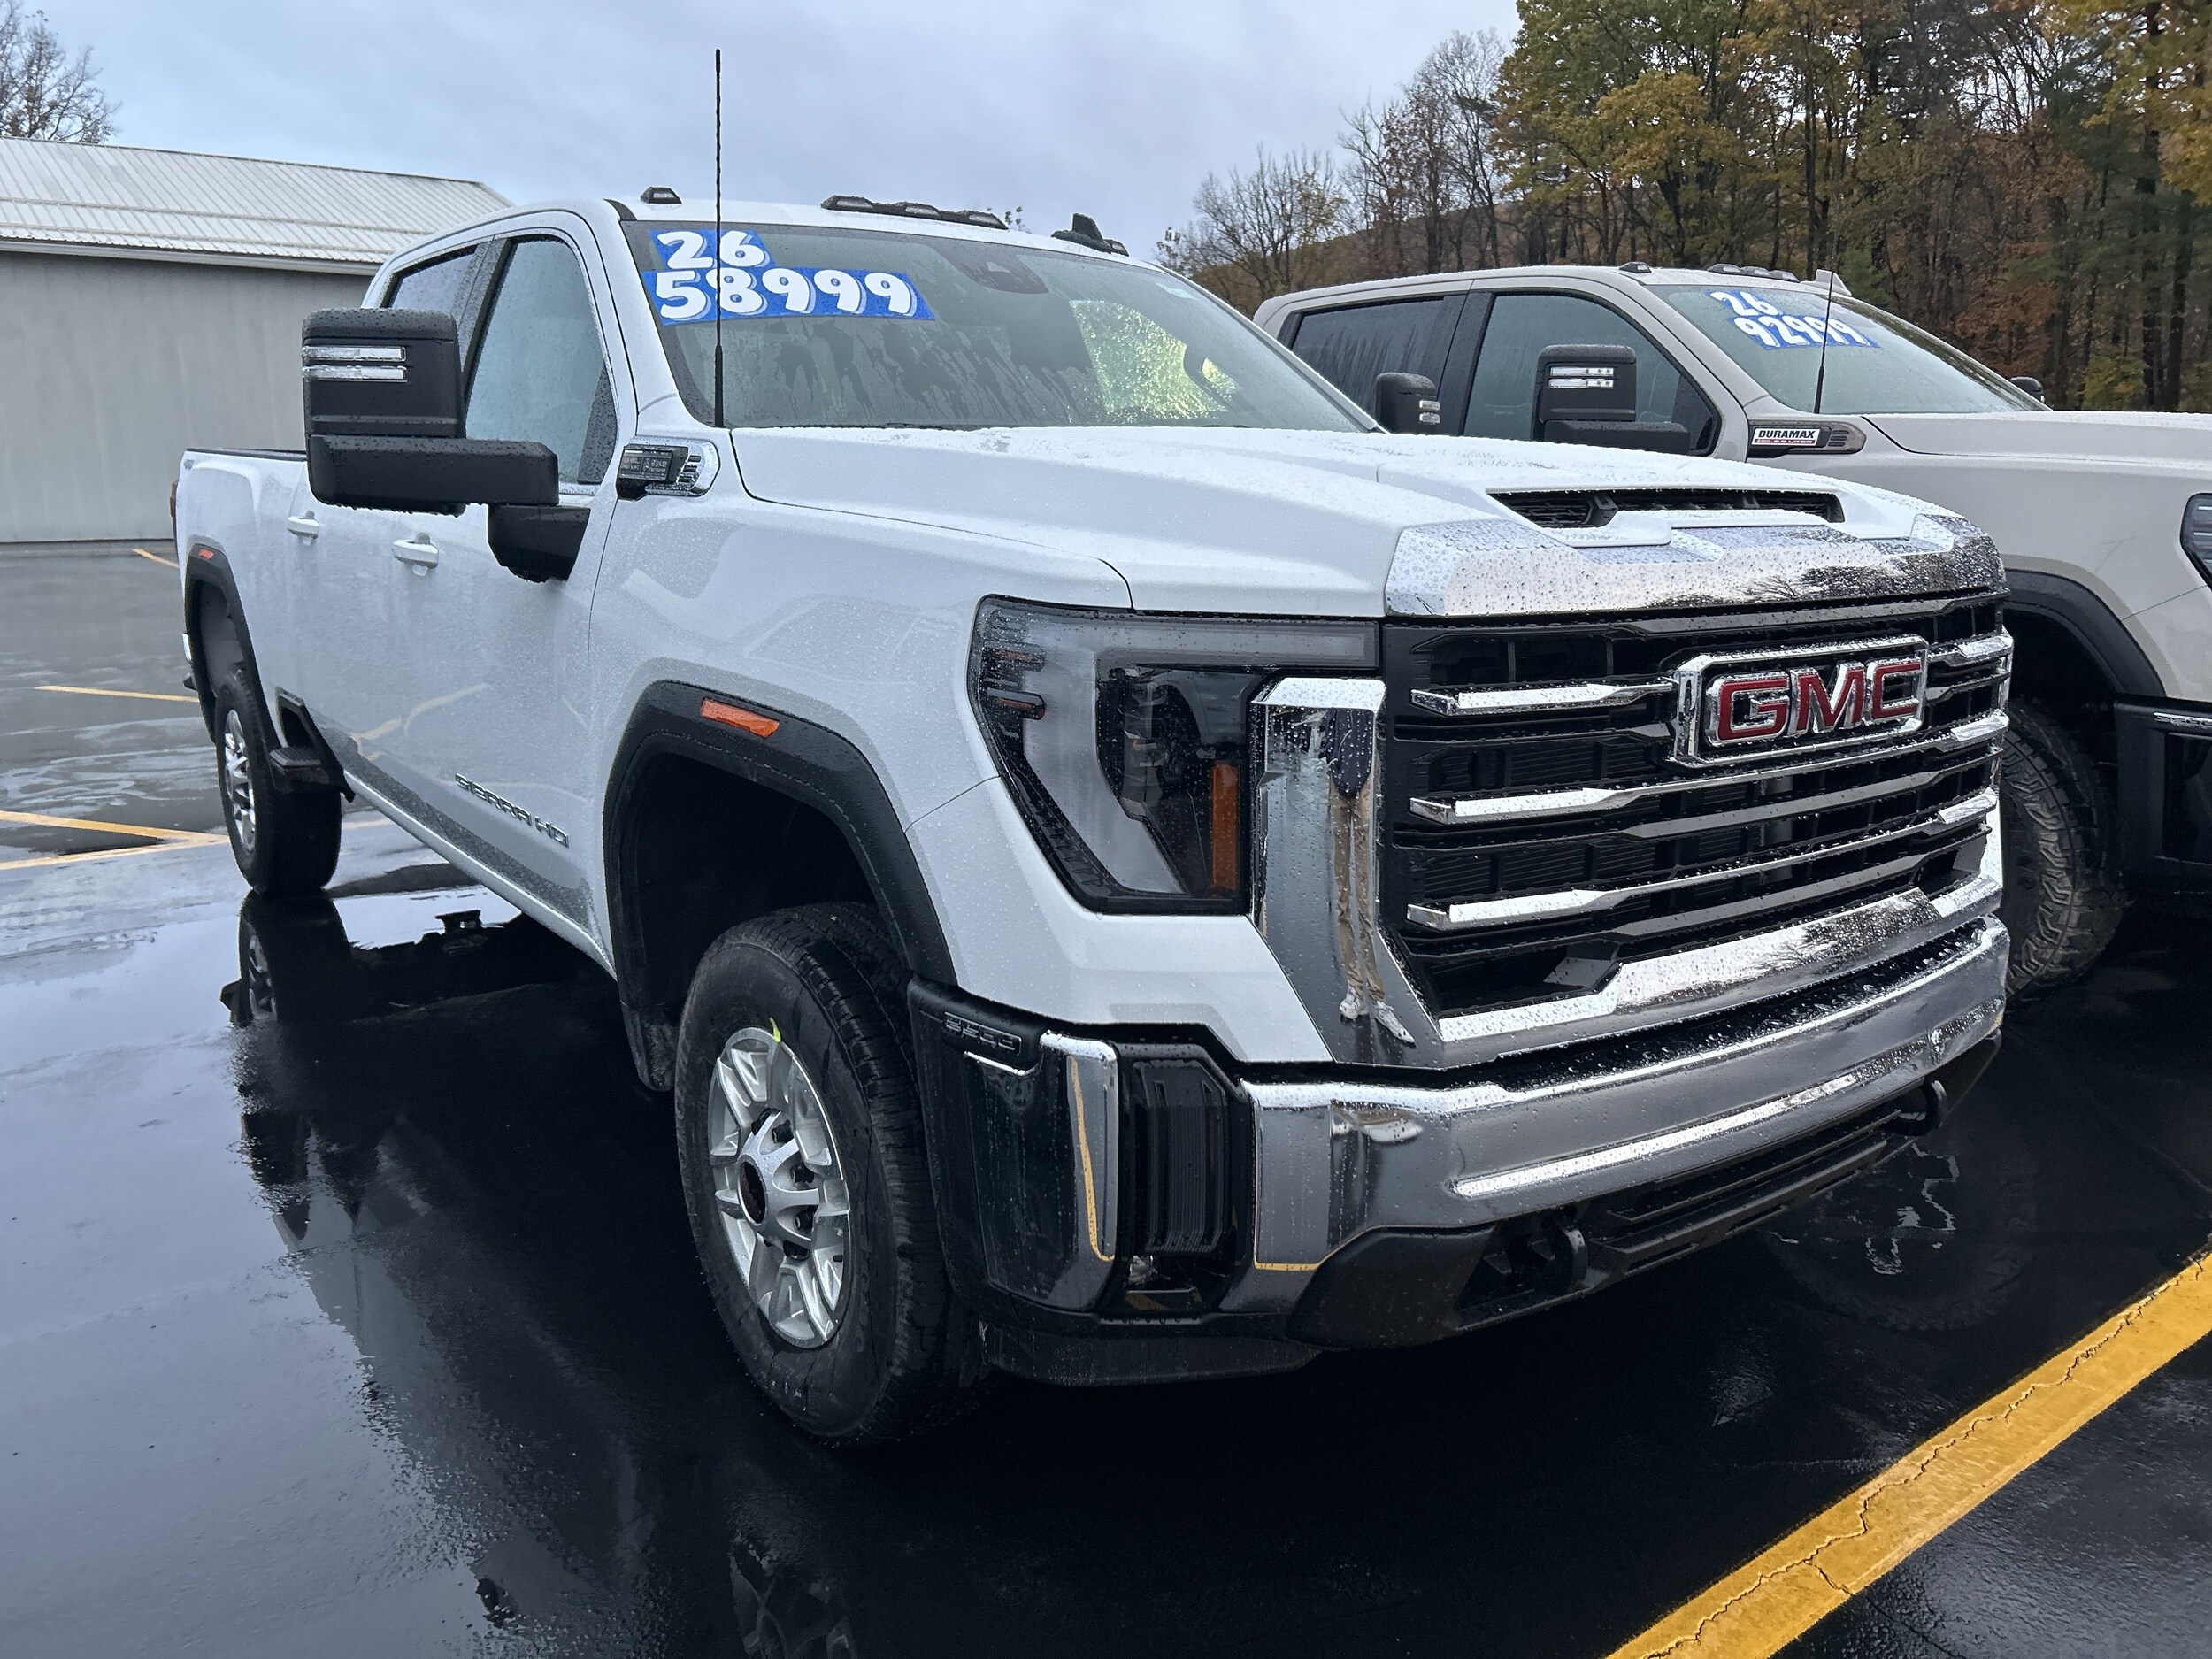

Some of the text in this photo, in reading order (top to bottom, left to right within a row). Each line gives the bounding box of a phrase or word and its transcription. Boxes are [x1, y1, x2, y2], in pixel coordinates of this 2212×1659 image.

[657, 229, 772, 269] 26
[655, 267, 918, 319] 58999
[1709, 291, 1783, 316] 26
[1734, 315, 1870, 348] 92999
[1758, 430, 1816, 439] DURAMAX
[1707, 657, 1922, 747] GMC
[455, 772, 569, 849] SIERRA HD
